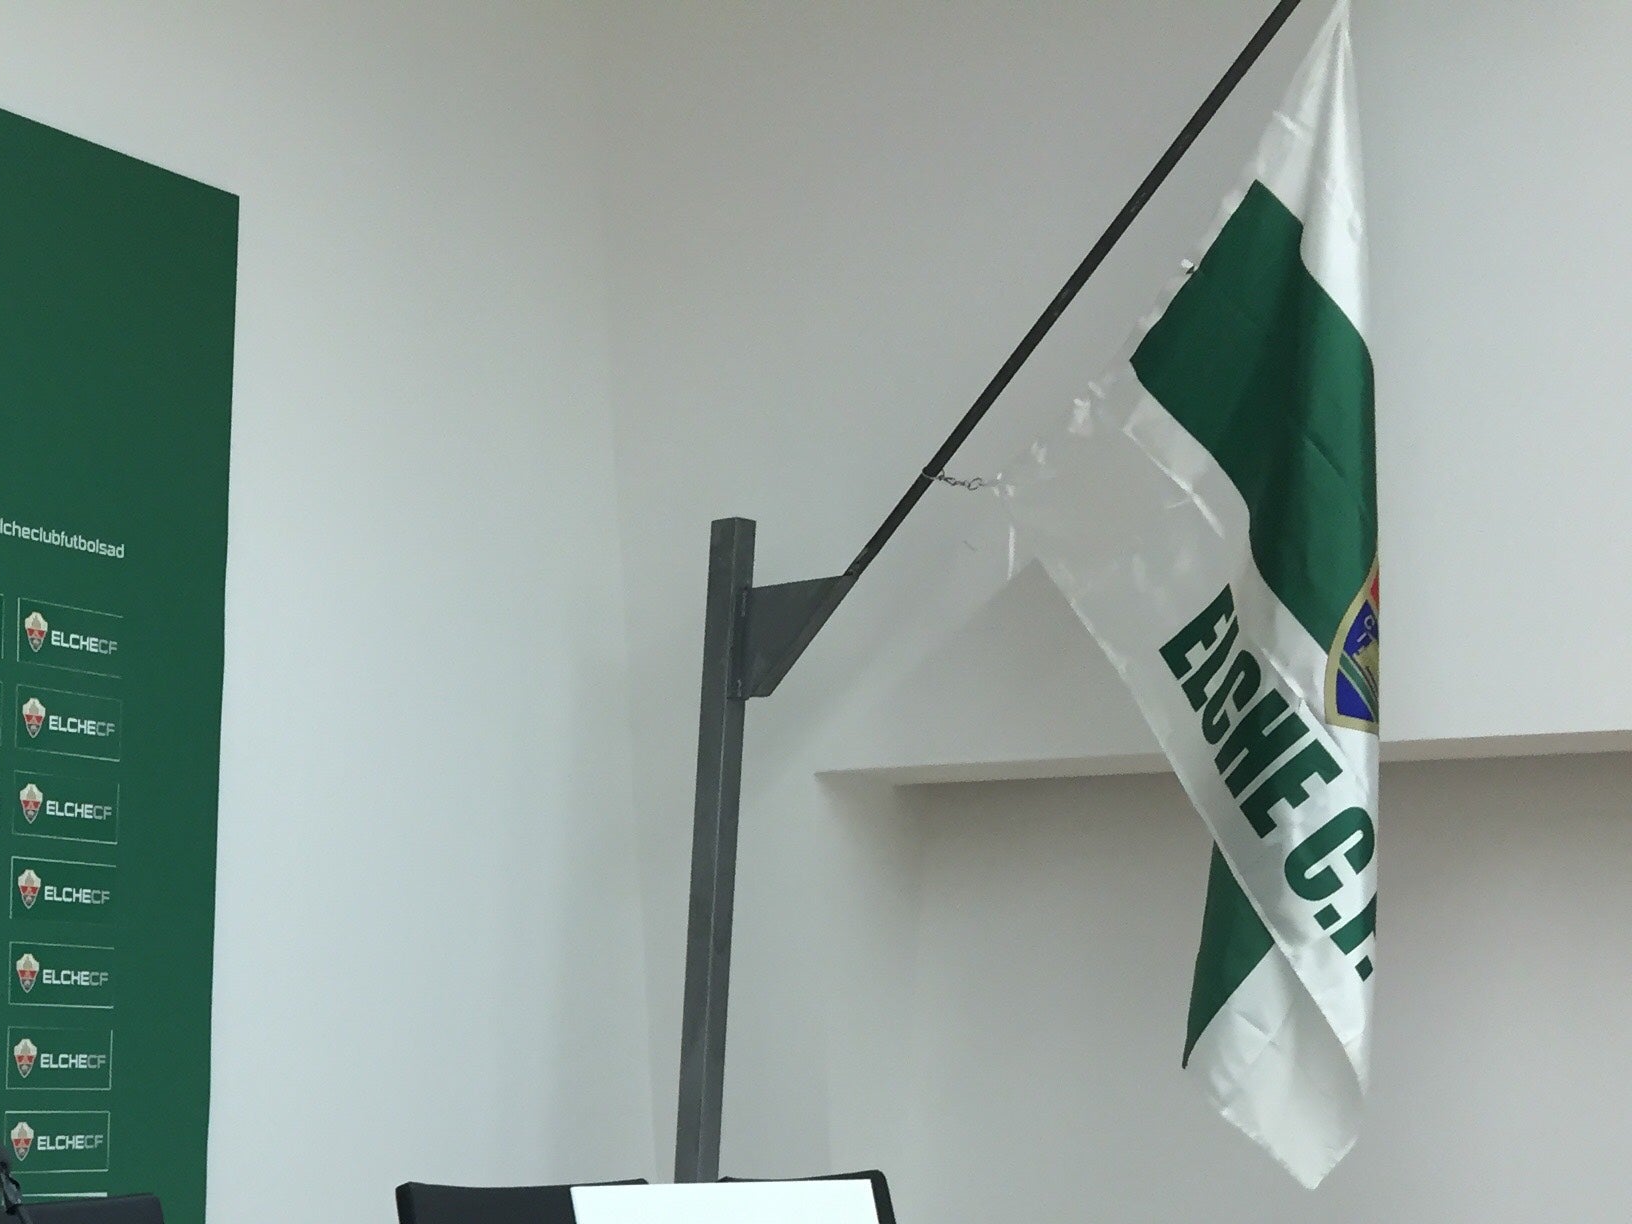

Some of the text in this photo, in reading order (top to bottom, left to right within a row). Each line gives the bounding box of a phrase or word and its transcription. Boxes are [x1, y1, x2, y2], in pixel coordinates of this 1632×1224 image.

[51, 629, 118, 655] ELCHECF
[1158, 583, 1343, 839] ELCHE
[48, 715, 116, 738] ELCHECF
[46, 800, 113, 821] ELCHECF
[44, 885, 111, 905] ELCHECF
[42, 969, 110, 987] ELCHECF
[40, 1053, 107, 1070] ELCHECF
[37, 1134, 104, 1151] ELCHECF
